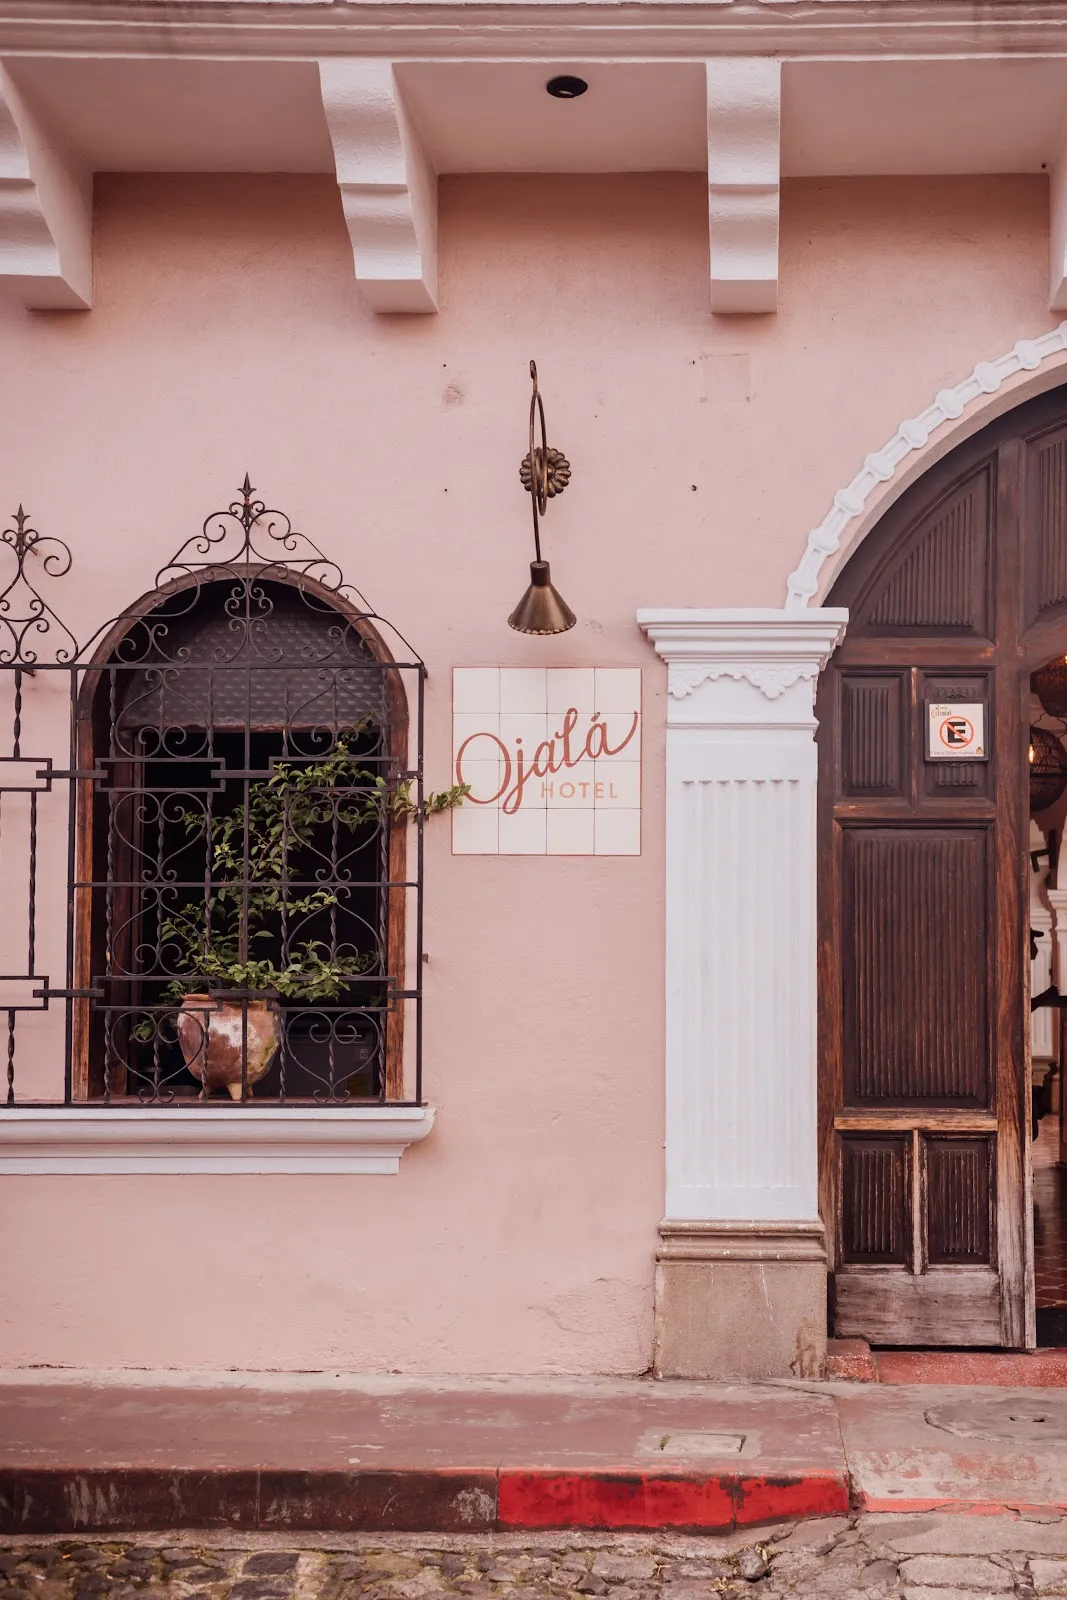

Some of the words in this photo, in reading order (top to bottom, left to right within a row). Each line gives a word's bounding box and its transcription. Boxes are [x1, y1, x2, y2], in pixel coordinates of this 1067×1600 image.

[947, 721, 966, 743] E
[456, 707, 638, 815] Ojalá
[540, 781, 618, 799] HOTEL
